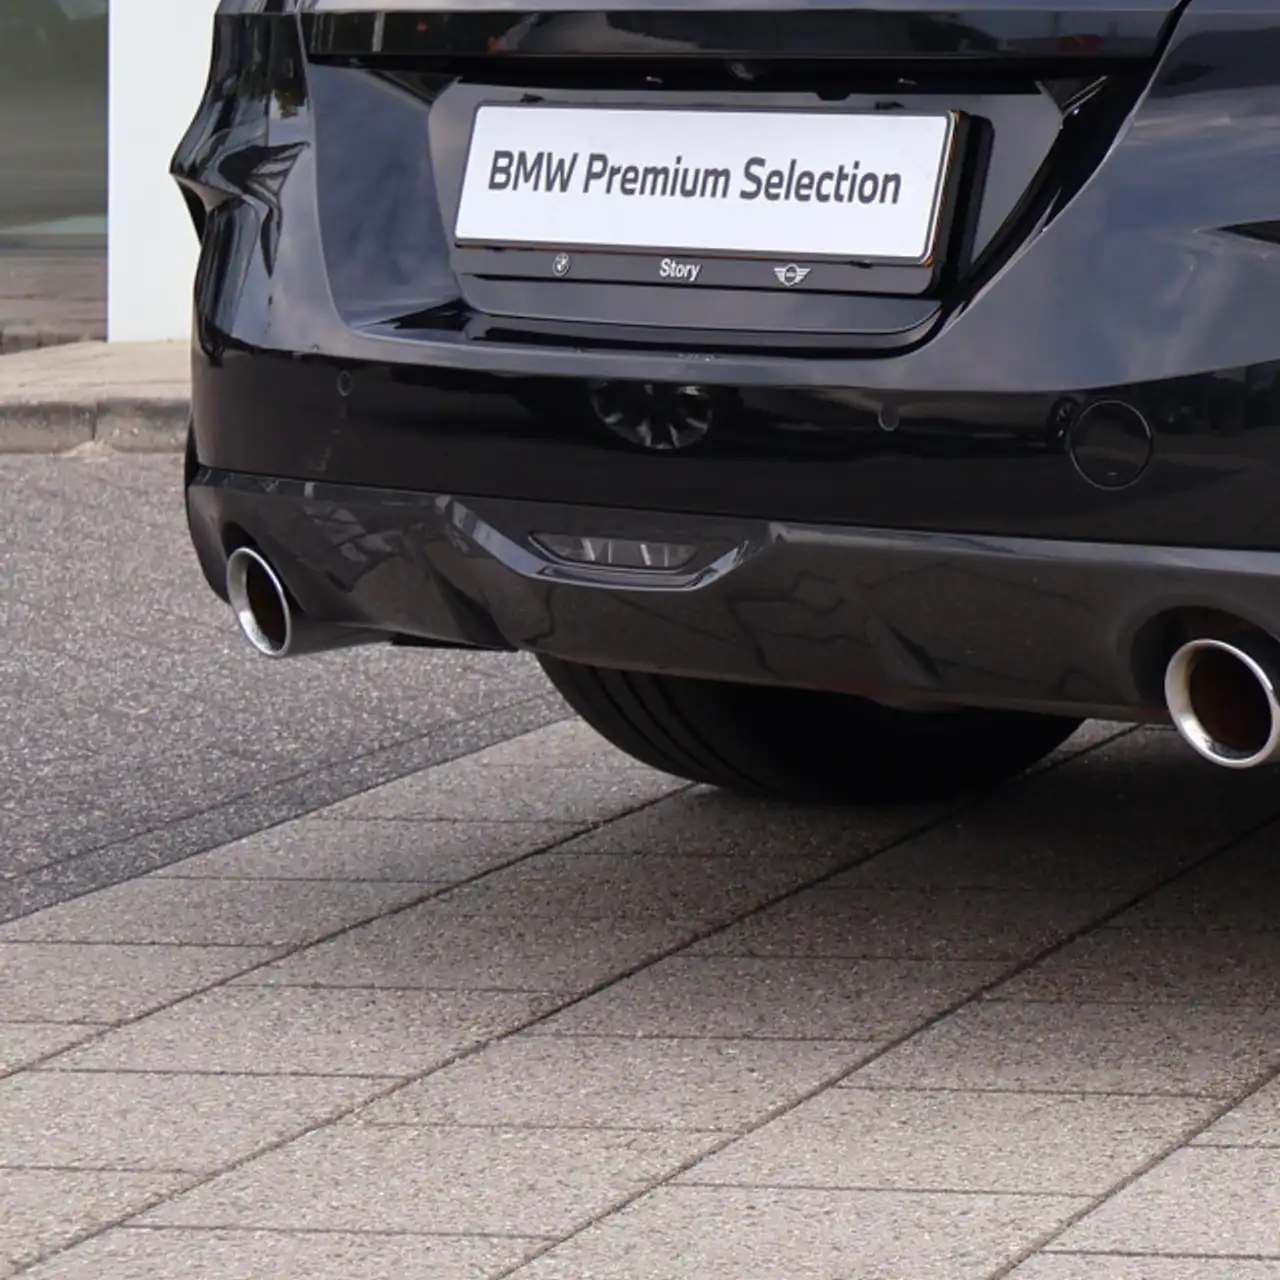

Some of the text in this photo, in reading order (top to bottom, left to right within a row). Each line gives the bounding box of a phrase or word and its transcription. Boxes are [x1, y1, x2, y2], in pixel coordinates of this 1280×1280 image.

[488, 150, 902, 204] BMW Premium Selection
[659, 258, 700, 281] Story
